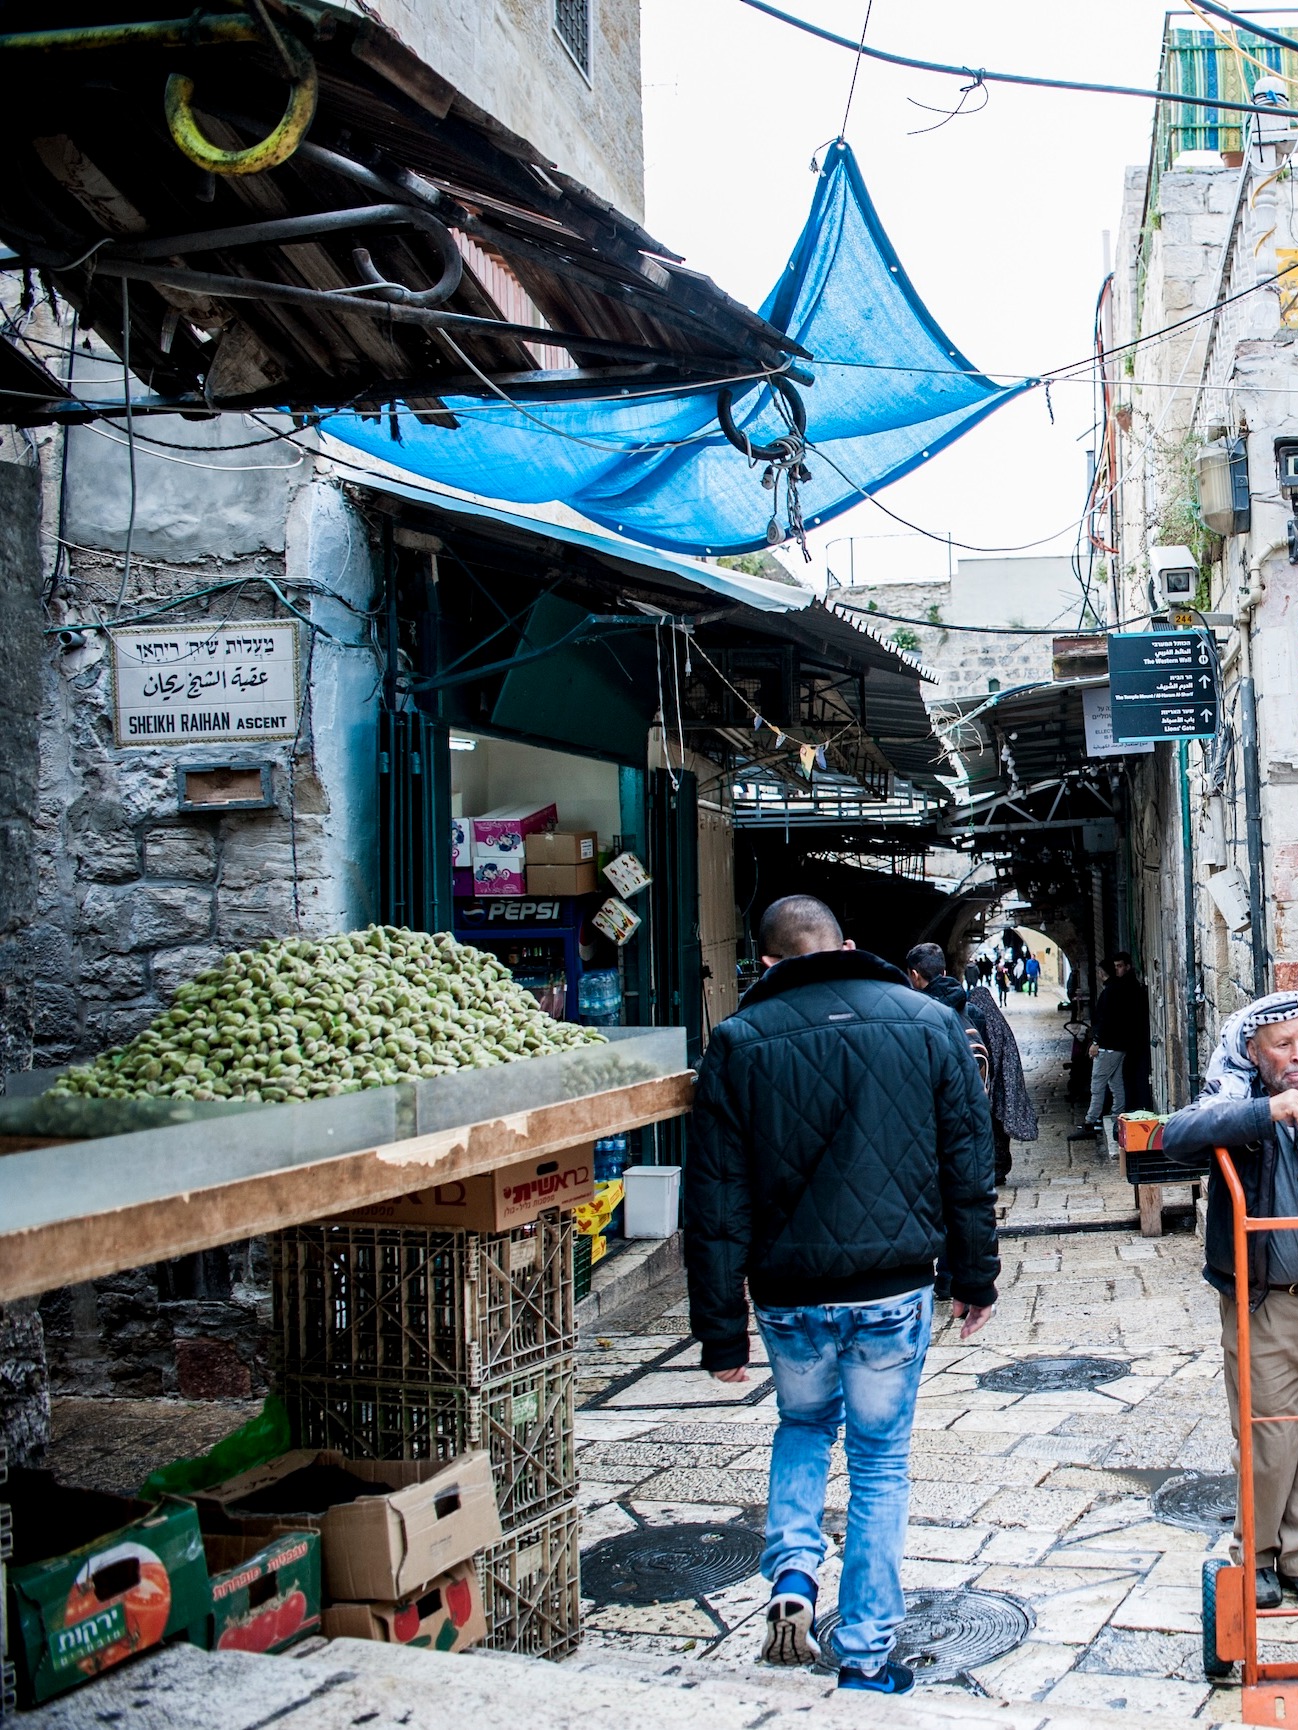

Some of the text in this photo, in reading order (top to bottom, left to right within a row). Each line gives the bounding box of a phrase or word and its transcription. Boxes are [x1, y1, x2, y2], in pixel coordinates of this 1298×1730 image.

[1175, 615, 1193, 624] 244
[1155, 657, 1179, 665] Western
[1179, 656, 1192, 664] Wall
[142, 672, 186, 702] ريحان
[187, 668, 227, 699] الشيخ
[129, 711, 288, 735] SHEIKH RAIHAN ASCENT
[487, 901, 561, 921] PEPSI
[58, 1608, 119, 1654] ירקות
